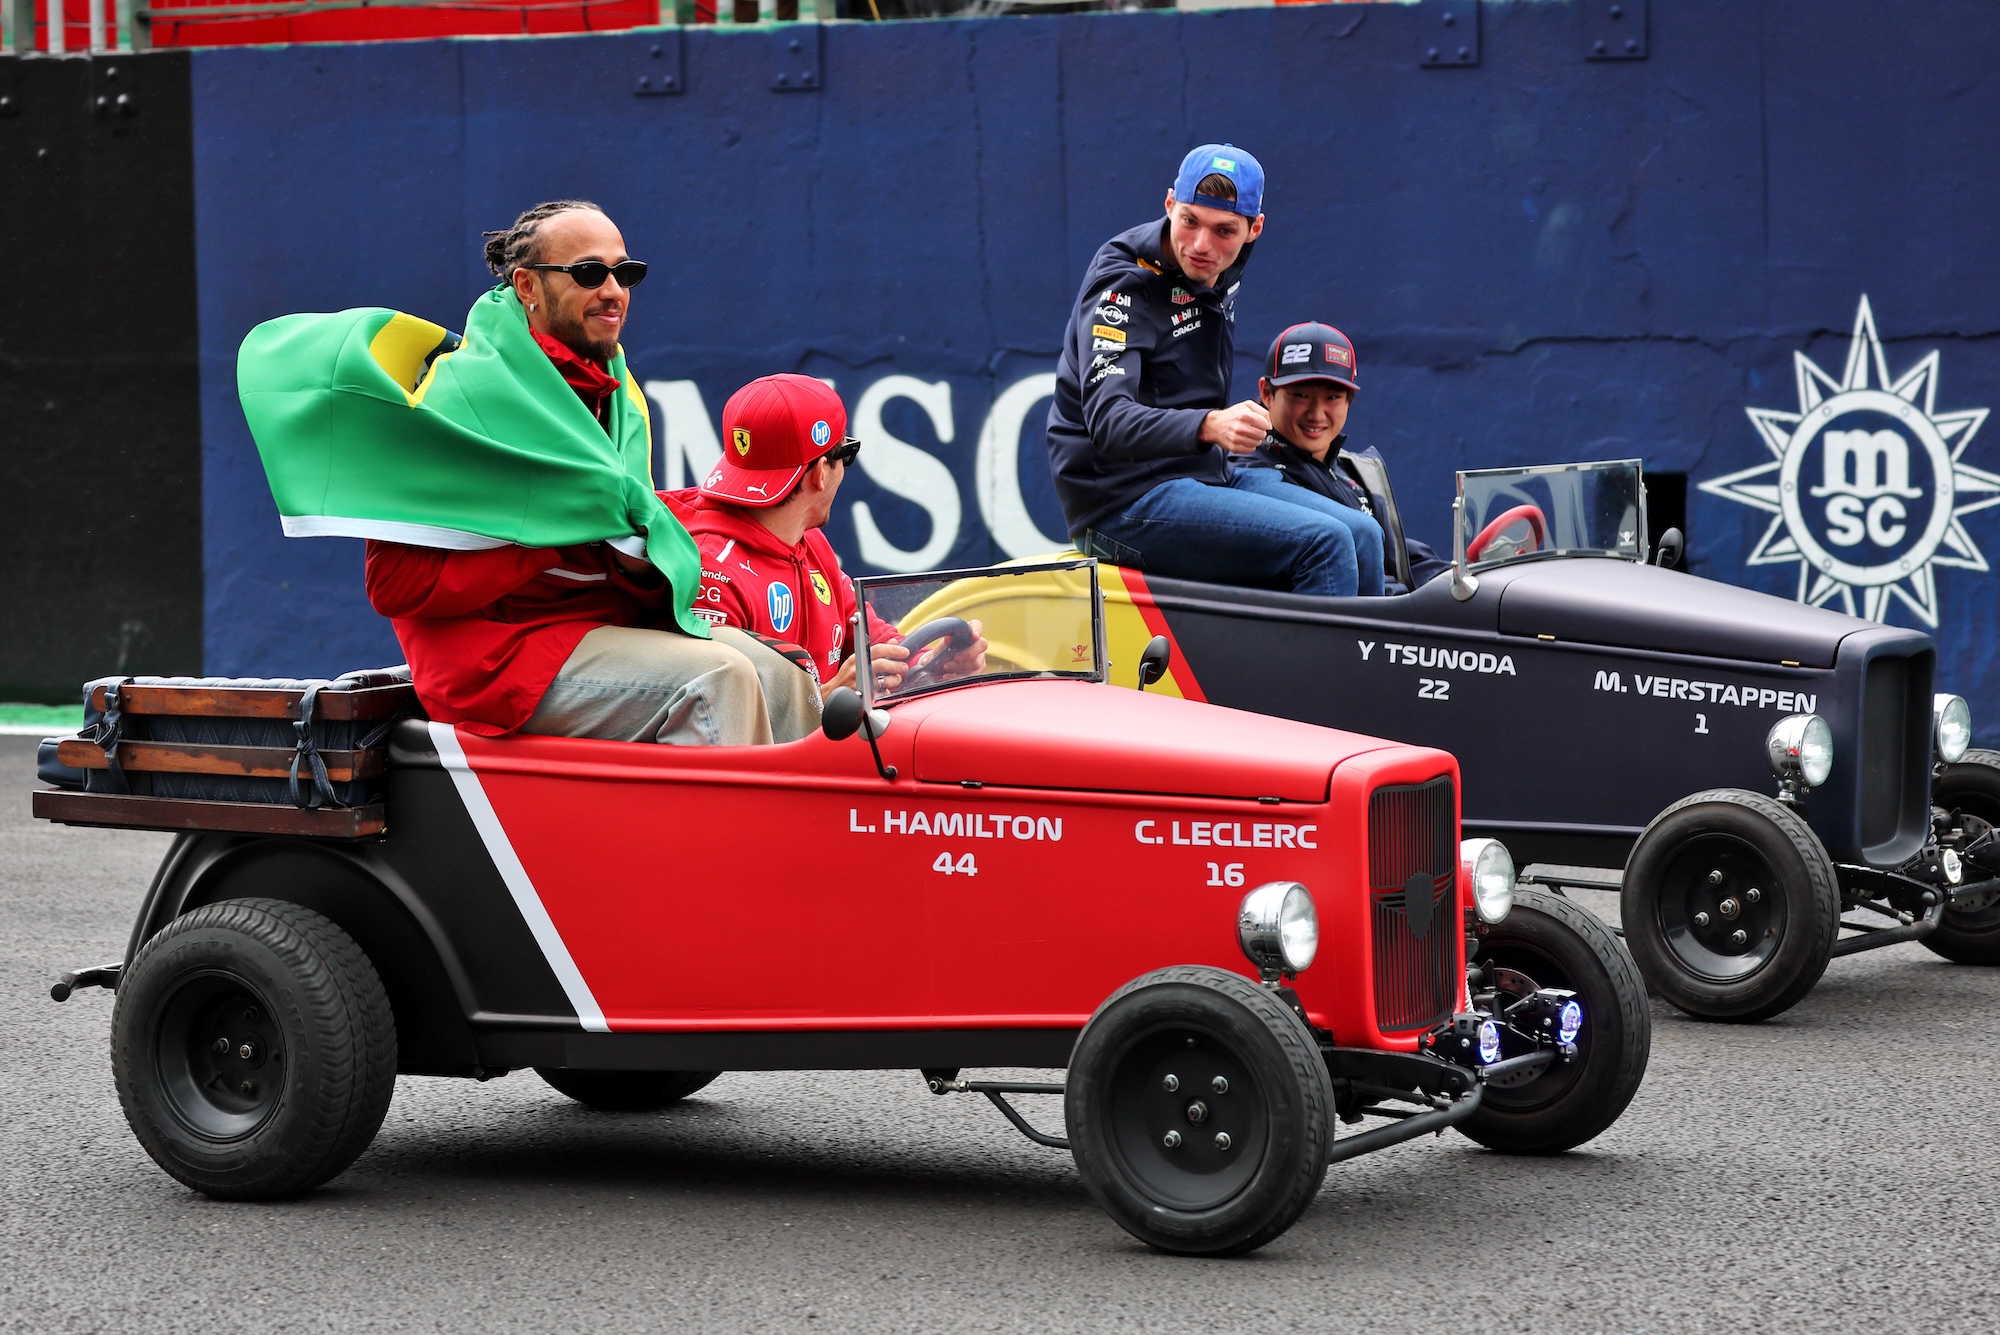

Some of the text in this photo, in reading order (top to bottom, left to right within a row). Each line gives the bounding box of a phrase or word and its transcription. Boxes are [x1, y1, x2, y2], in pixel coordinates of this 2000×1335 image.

[1100, 290, 1131, 307] Mobil
[1171, 308, 1192, 326] Mobil
[1172, 320, 1201, 338] ORACLE
[1281, 343, 1313, 365] 22
[814, 421, 829, 445] hp
[696, 584, 721, 602] CG
[769, 583, 791, 631] hp
[1358, 641, 1516, 675] Y TSUNODA
[1418, 678, 1450, 700] 22
[1594, 670, 1817, 714] M. VERSTAPPEN
[1694, 713, 1709, 734] 1
[850, 808, 1063, 841] L. HAMILTON
[1135, 820, 1317, 849] C. LECLERC
[932, 852, 978, 876] 44
[1206, 862, 1245, 887] 16
